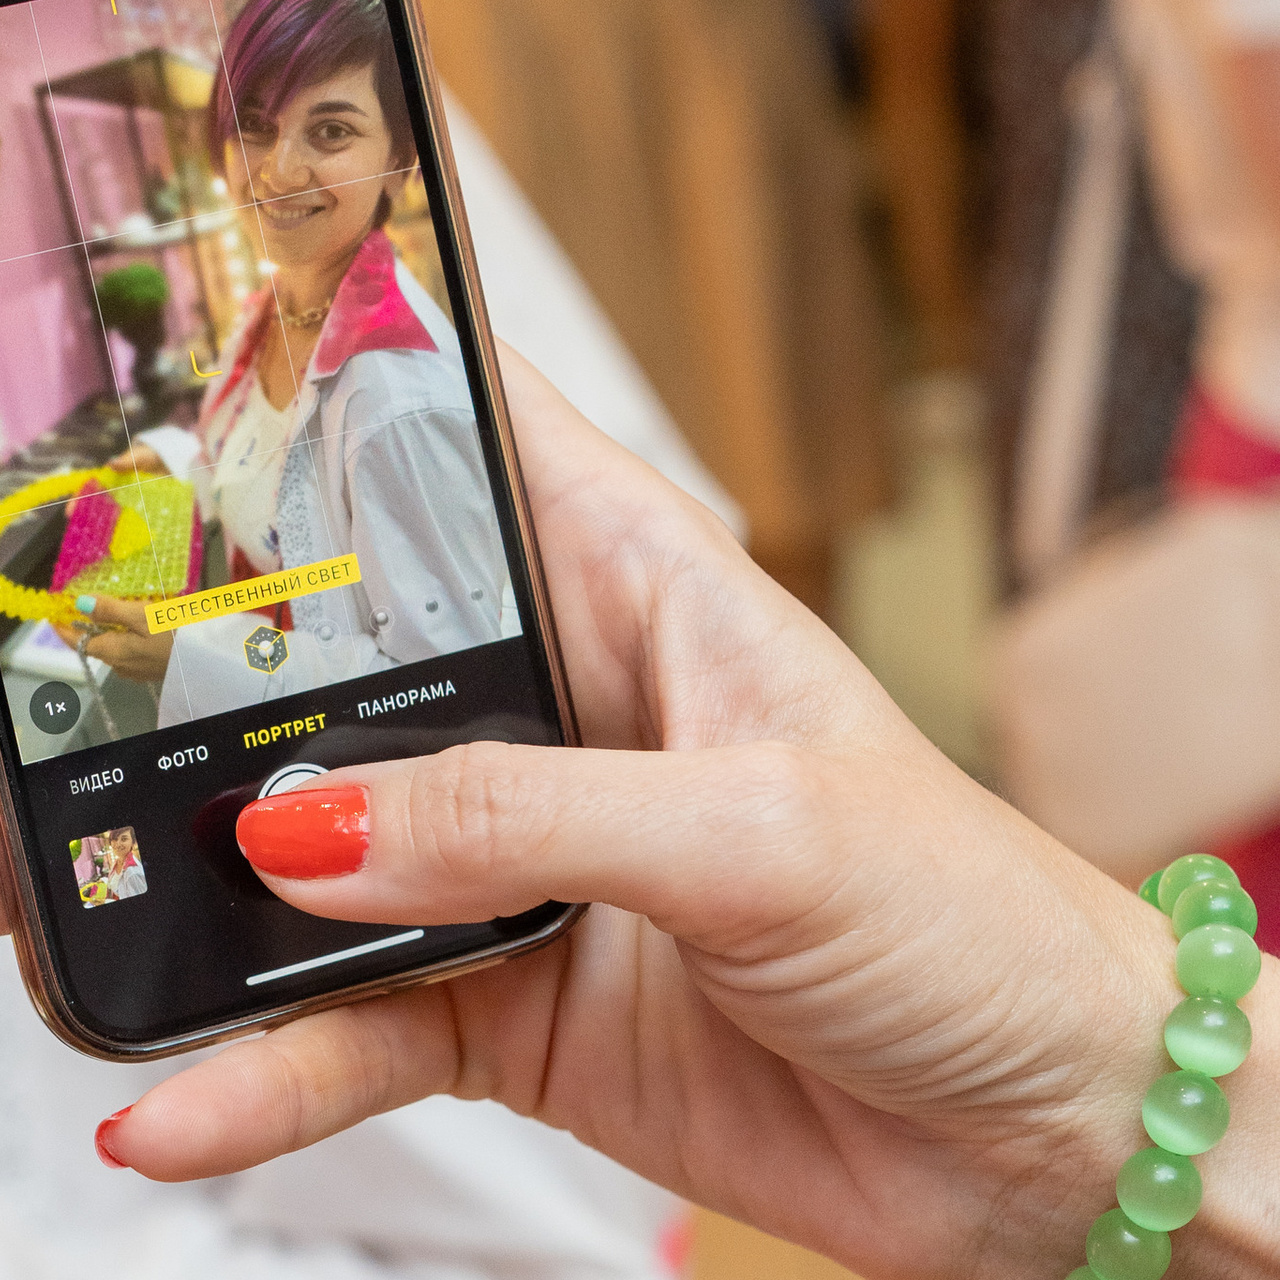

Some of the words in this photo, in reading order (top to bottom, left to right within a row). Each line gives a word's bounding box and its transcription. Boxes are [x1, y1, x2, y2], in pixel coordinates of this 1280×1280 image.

[154, 572, 301, 625] ЕСТЕСТВЕННЫЙ
[307, 562, 352, 587] СВЕТ
[69, 767, 124, 795] ВИДЕО
[157, 745, 209, 771] ФОТО
[243, 713, 327, 749] ПОРТРЕТ
[357, 679, 457, 719] ПАНОРАМА
